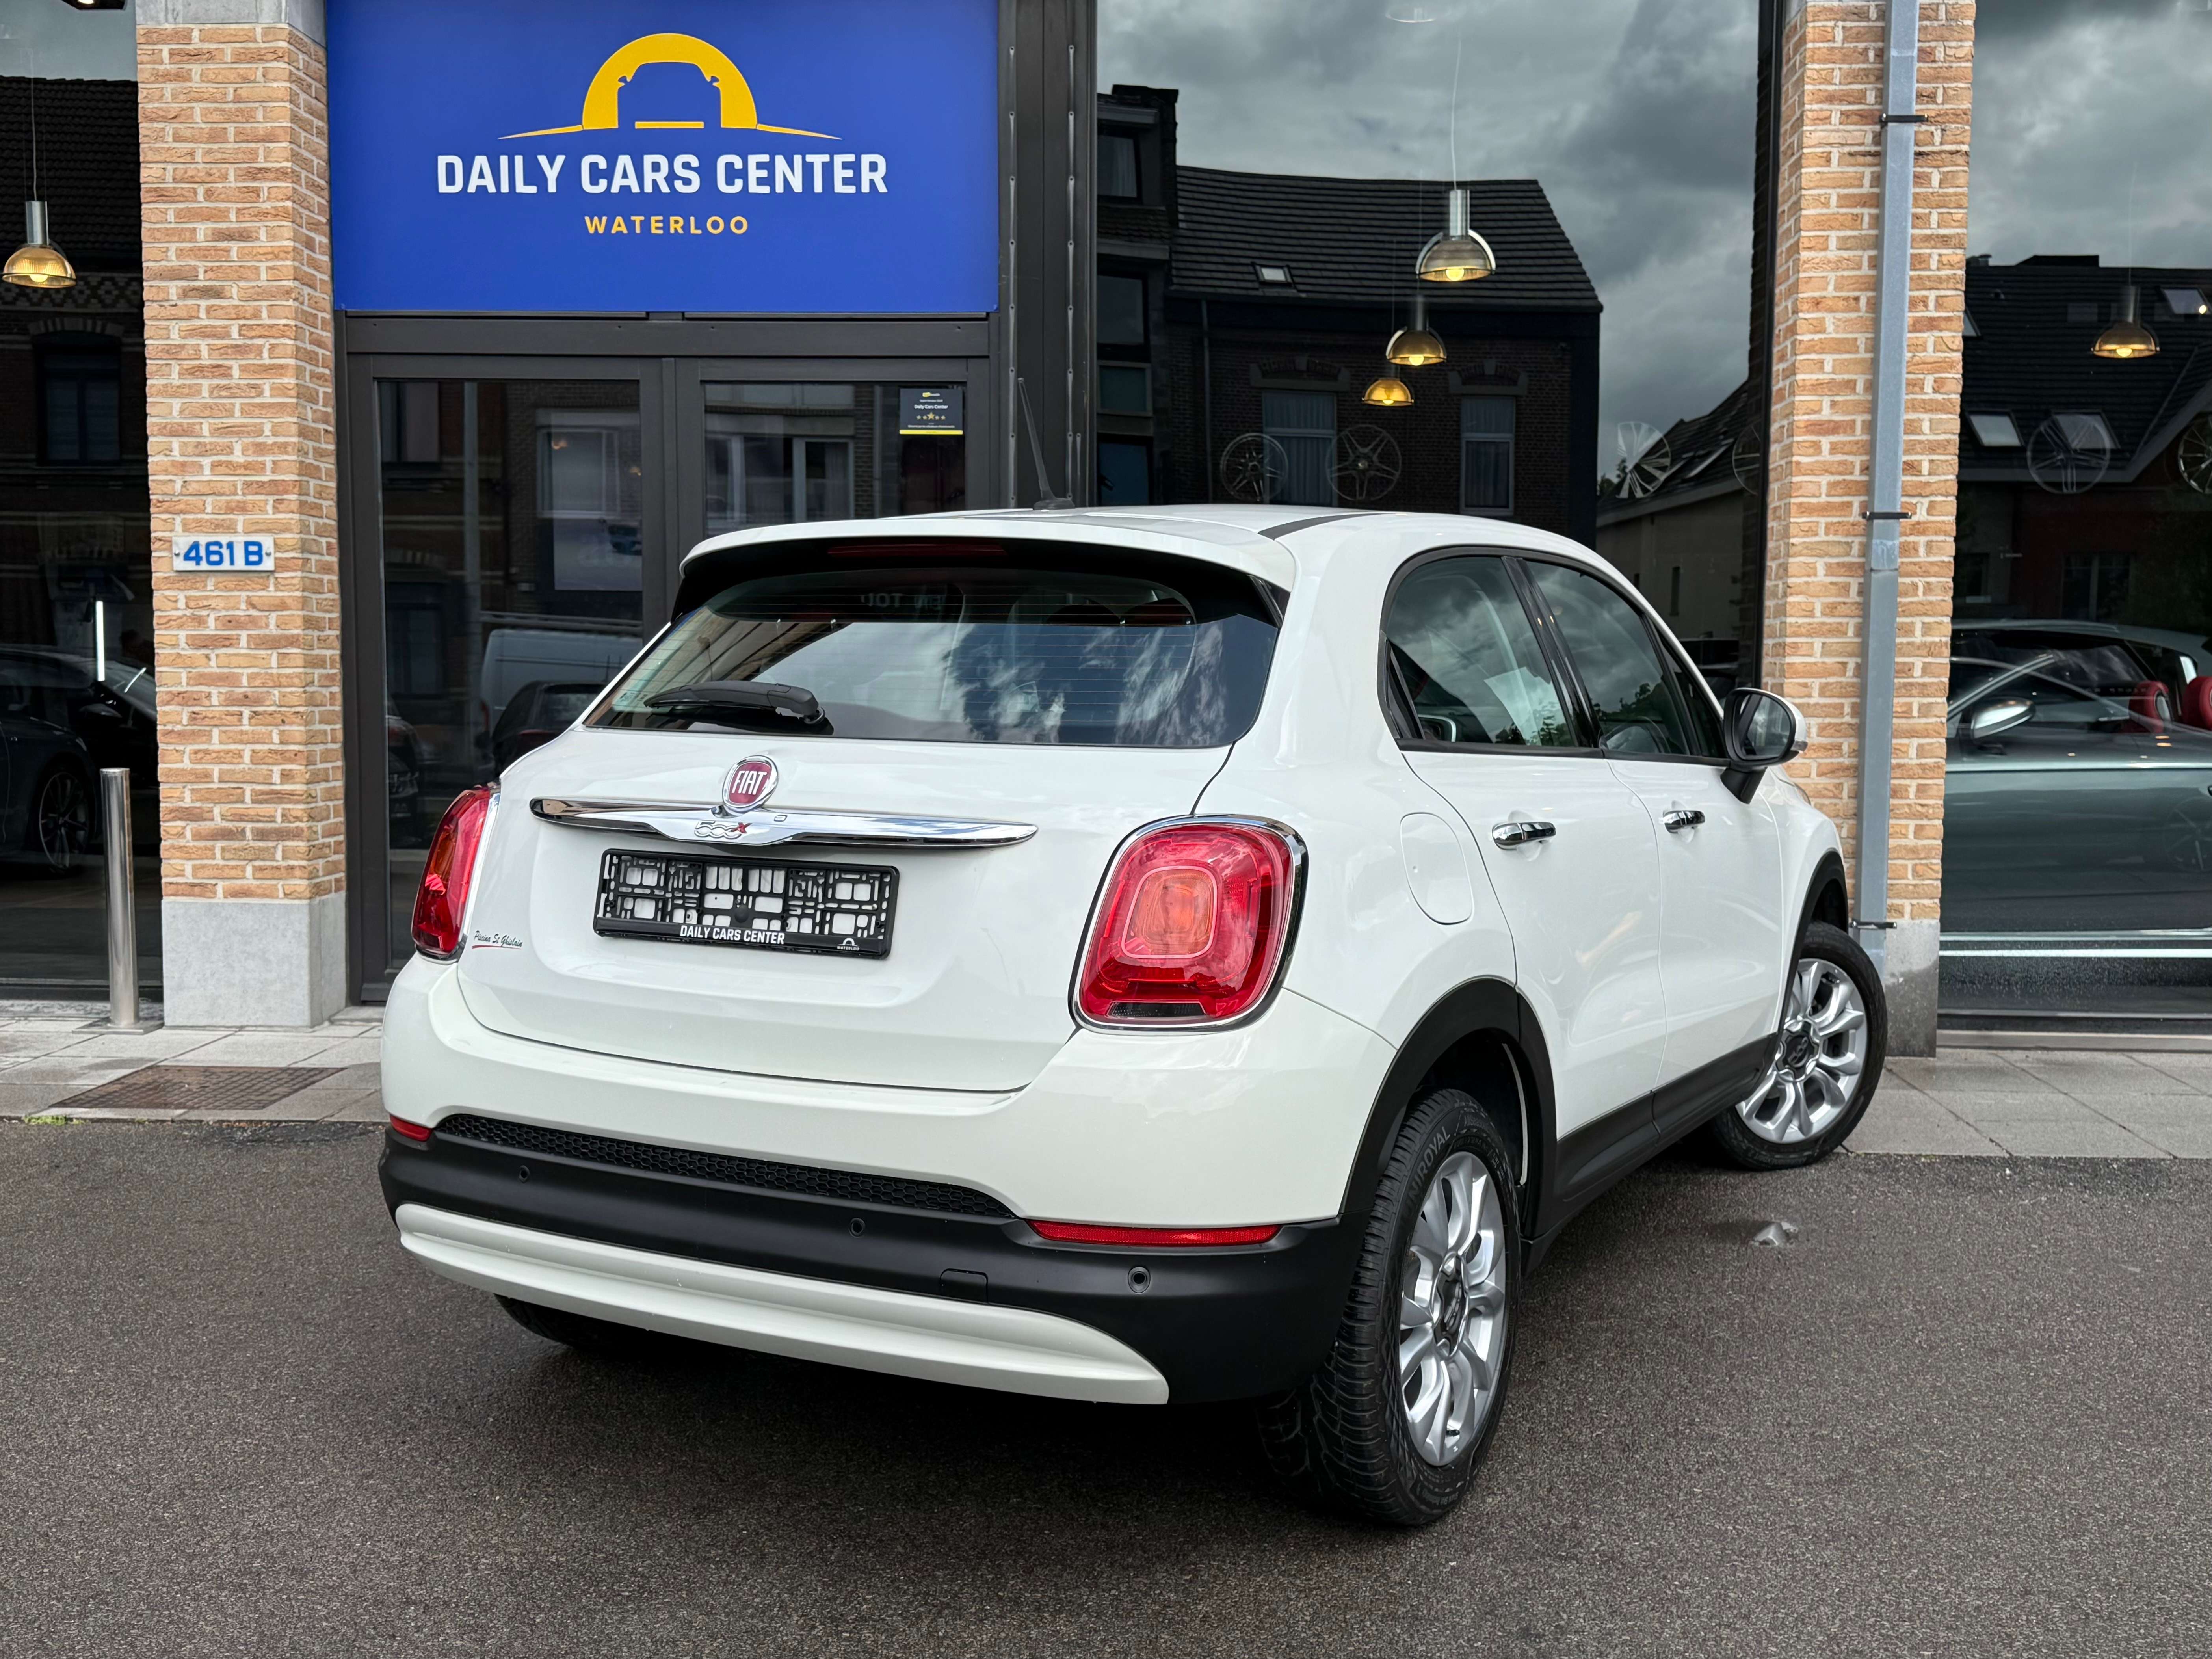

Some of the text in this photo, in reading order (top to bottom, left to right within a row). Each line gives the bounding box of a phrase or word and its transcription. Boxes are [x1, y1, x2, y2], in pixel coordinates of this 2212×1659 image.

[437, 154, 888, 193] DAILY CARS CENTER
[584, 216, 748, 234] WATERLOO
[183, 541, 264, 566] 461 B
[731, 770, 767, 795] FIAT
[501, 935, 523, 947] Ghislain
[680, 925, 785, 945] DAILY CARS CENTER
